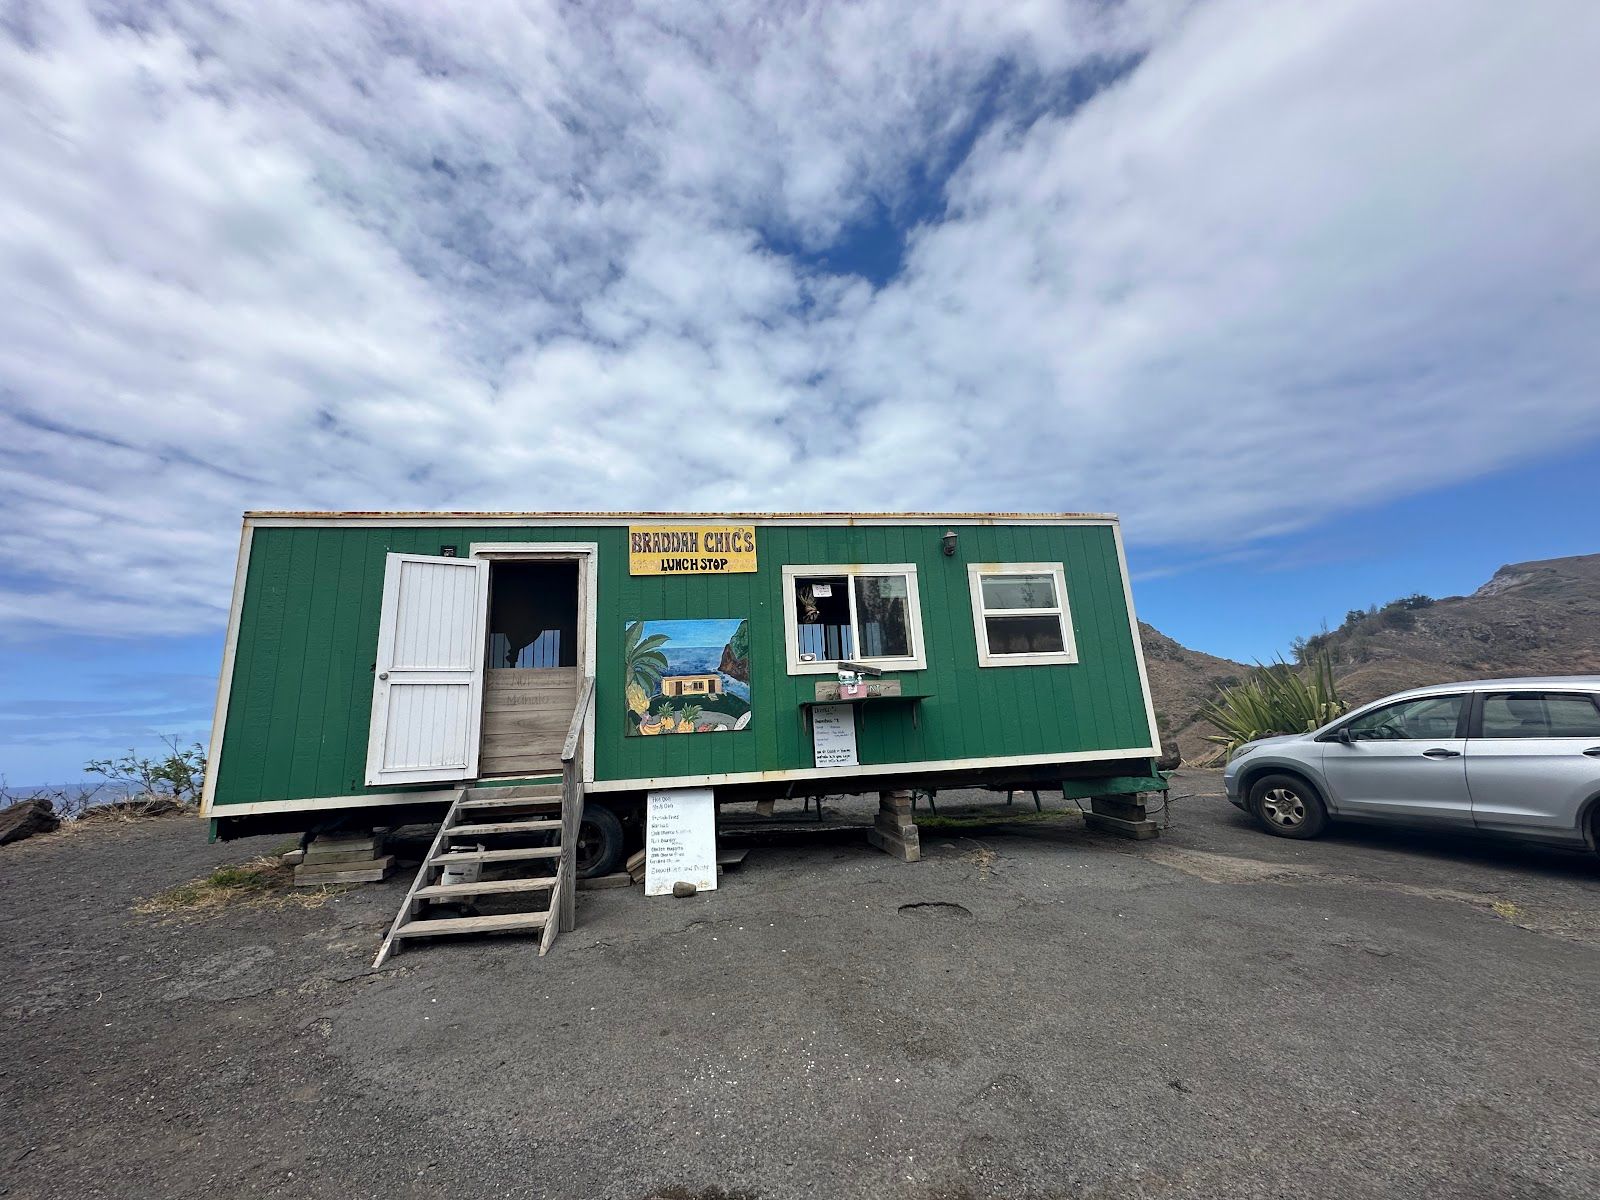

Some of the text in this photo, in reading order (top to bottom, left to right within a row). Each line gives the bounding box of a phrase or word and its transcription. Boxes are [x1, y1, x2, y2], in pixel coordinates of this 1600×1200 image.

[631, 528, 754, 553] BRADDAH CHIC'S
[661, 558, 699, 571] LUNCH
[700, 558, 728, 570] STOP
